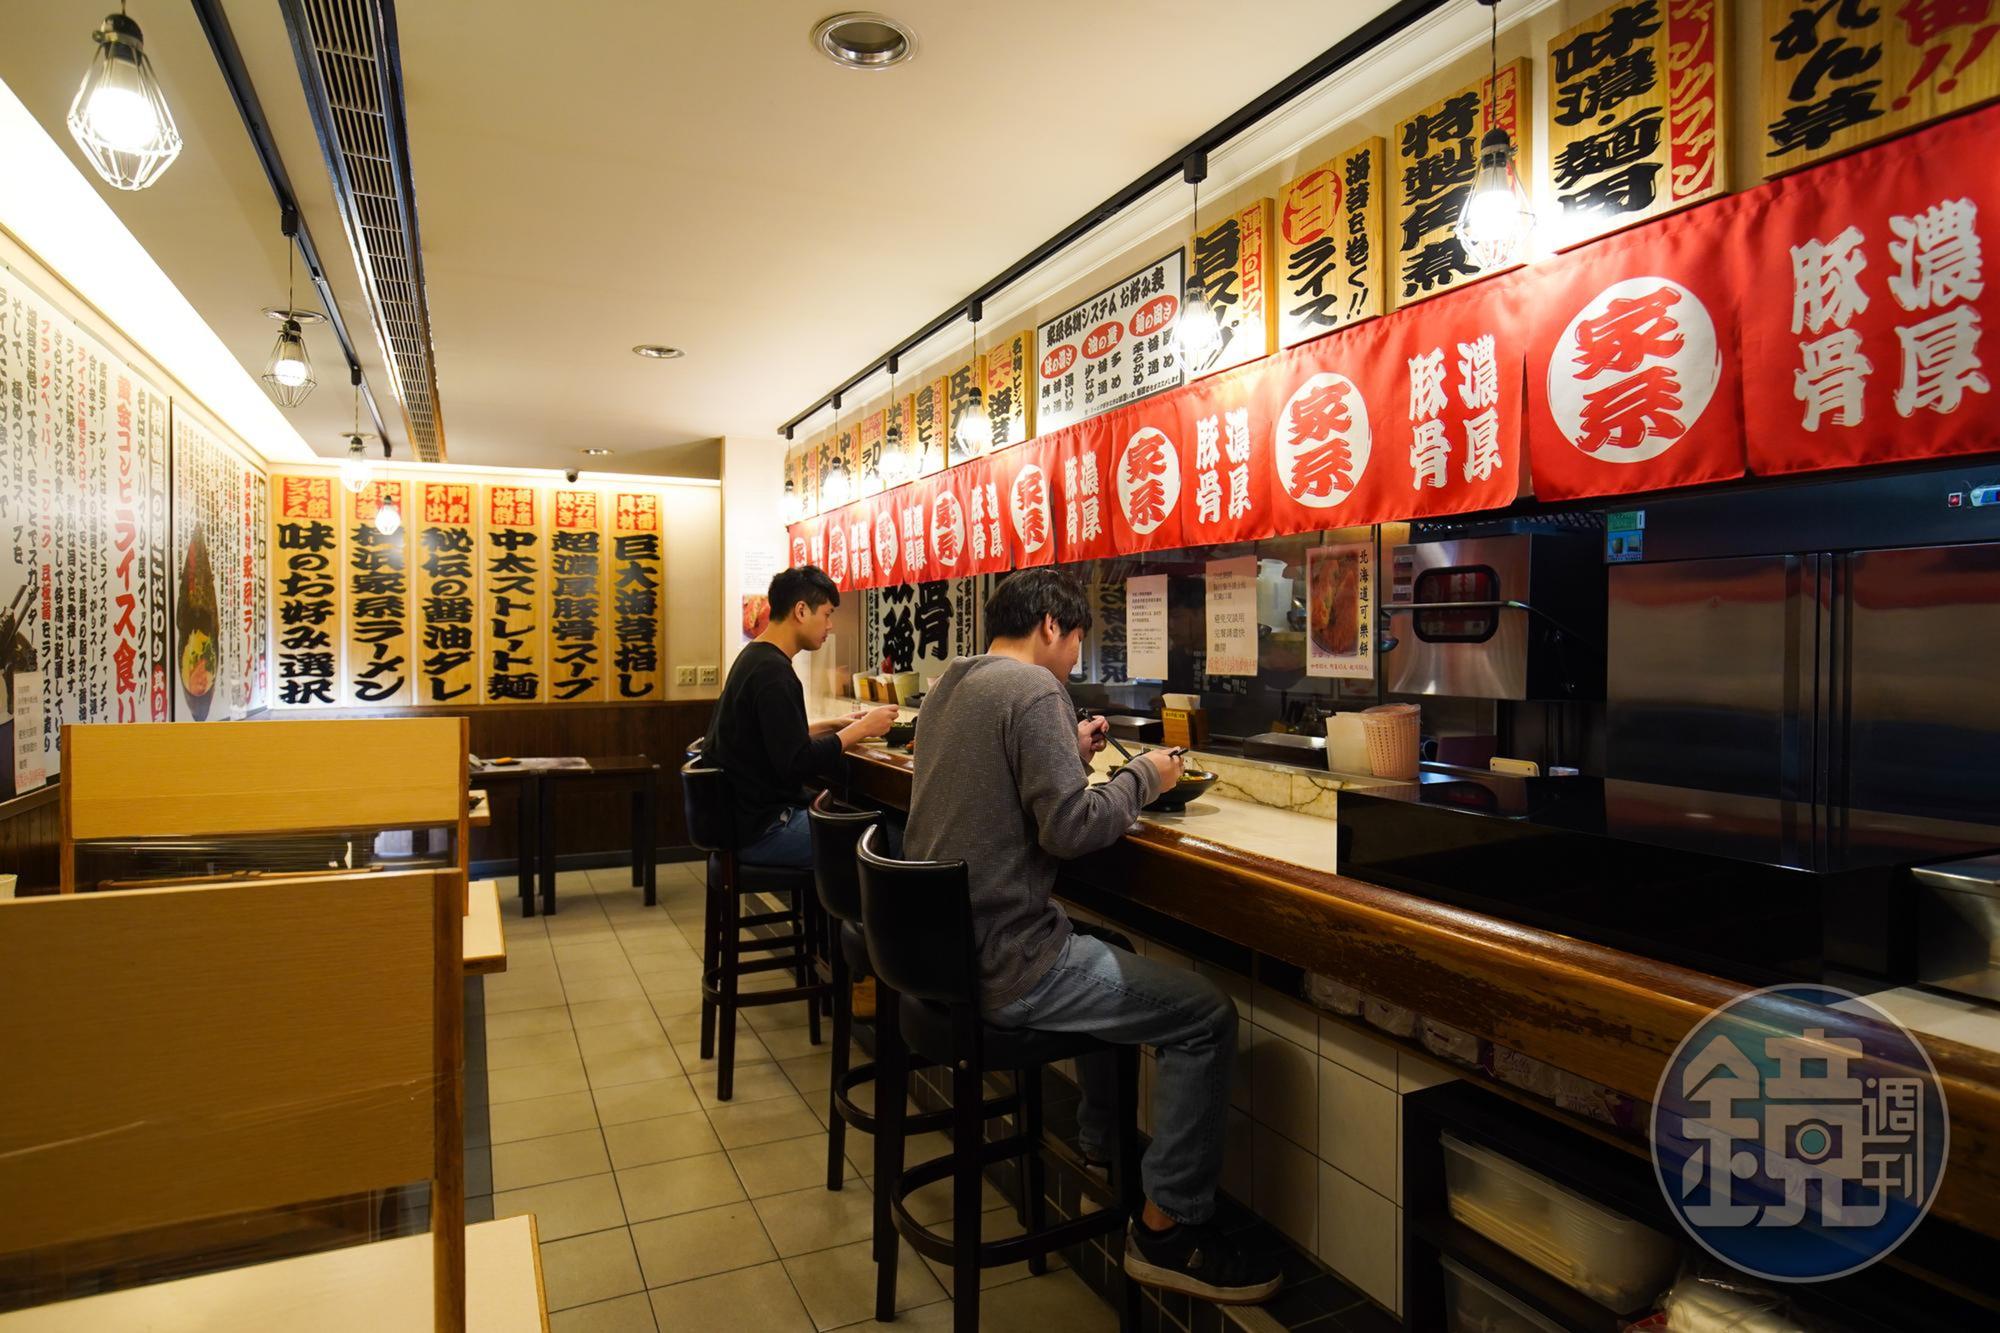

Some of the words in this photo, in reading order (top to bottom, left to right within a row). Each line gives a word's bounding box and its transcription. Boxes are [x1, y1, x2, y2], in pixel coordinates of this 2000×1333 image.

[1790, 224, 1875, 433] 豚骨
[1888, 196, 1991, 419] 濃厚
[1407, 351, 1450, 490] 豚骨
[1457, 333, 1504, 483] 濃厚
[1570, 286, 1688, 453] 家系
[1080, 450, 1102, 542] 濃厚
[1126, 434, 1167, 527] 家系
[1195, 414, 1222, 525] 豚骨
[1225, 407, 1251, 520] 濃厚
[1289, 381, 1355, 500] 家系
[427, 486, 447, 522] 不出
[448, 486, 469, 522] 門外
[935, 496, 959, 561] 家系
[971, 485, 985, 560] 豚骨
[985, 482, 1004, 558] 濃厚
[1017, 471, 1044, 547] 家系
[1064, 455, 1078, 545] 豚骨
[277, 521, 336, 704] 味のお好み選択
[422, 527, 474, 701] 秘伝の醤油ダレ
[488, 528, 538, 700] 中太ストレート麺
[552, 530, 600, 699] 超濃厚豚骨スープ
